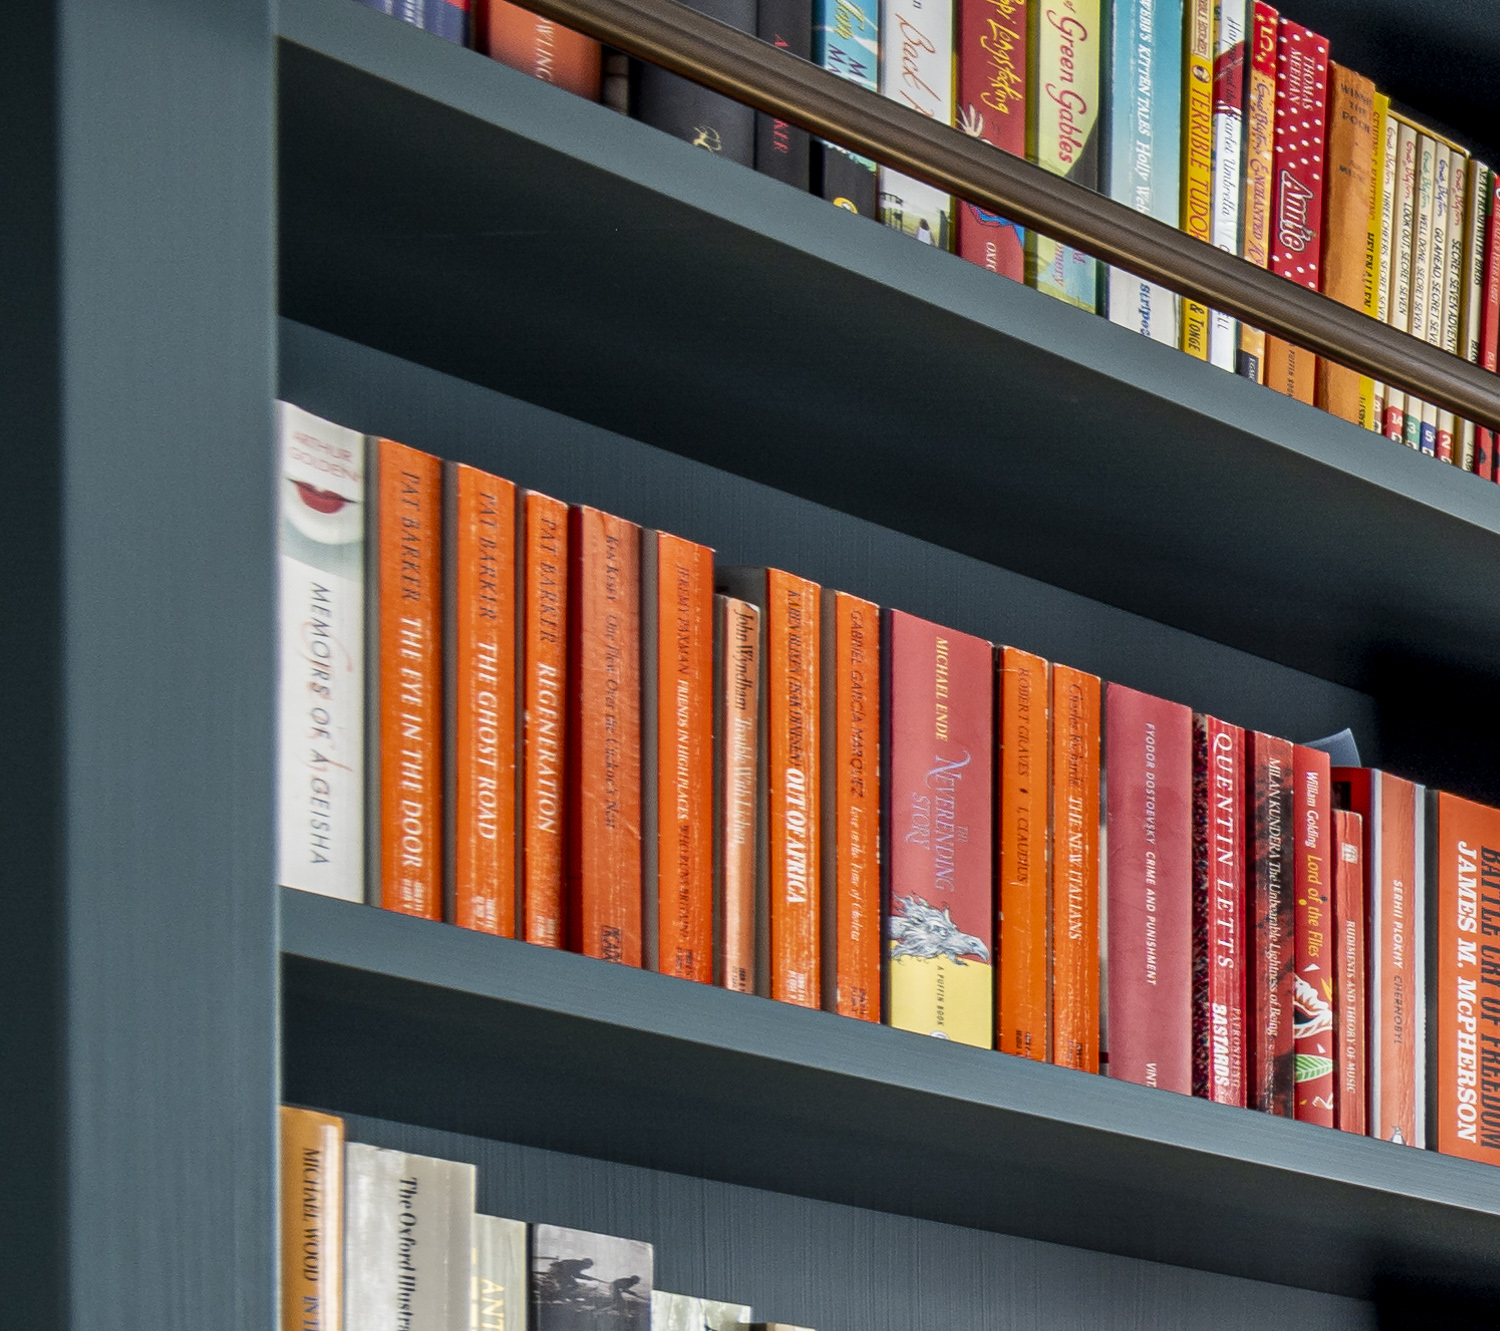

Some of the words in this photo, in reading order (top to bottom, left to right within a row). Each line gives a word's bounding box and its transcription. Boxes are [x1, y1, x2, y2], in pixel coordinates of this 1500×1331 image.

[1046, 9, 1087, 83] Green
[1288, 48, 1301, 104] MEEHAN
[1301, 55, 1314, 110] THOMAS
[1047, 89, 1087, 163] Gables
[1280, 171, 1316, 251] Annie
[1401, 203, 1414, 225] LOOK
[1398, 283, 1409, 315] SEVEN
[1399, 251, 1411, 282] SECRET
[478, 491, 496, 531] PAT
[478, 539, 496, 620] BARKER
[307, 582, 331, 696] MEMOIRS
[477, 641, 497, 685] THE
[309, 707, 331, 736] OF
[477, 693, 497, 768] GHOST
[309, 750, 331, 767] A
[307, 777, 331, 866] GEISHA
[477, 777, 497, 839] ROAD
[1215, 732, 1234, 866] QUENTIN
[1456, 841, 1477, 932] JAMES
[1216, 878, 1236, 970] LETTS
[1456, 939, 1477, 970] M.
[1456, 977, 1478, 1142] McPHERSON
